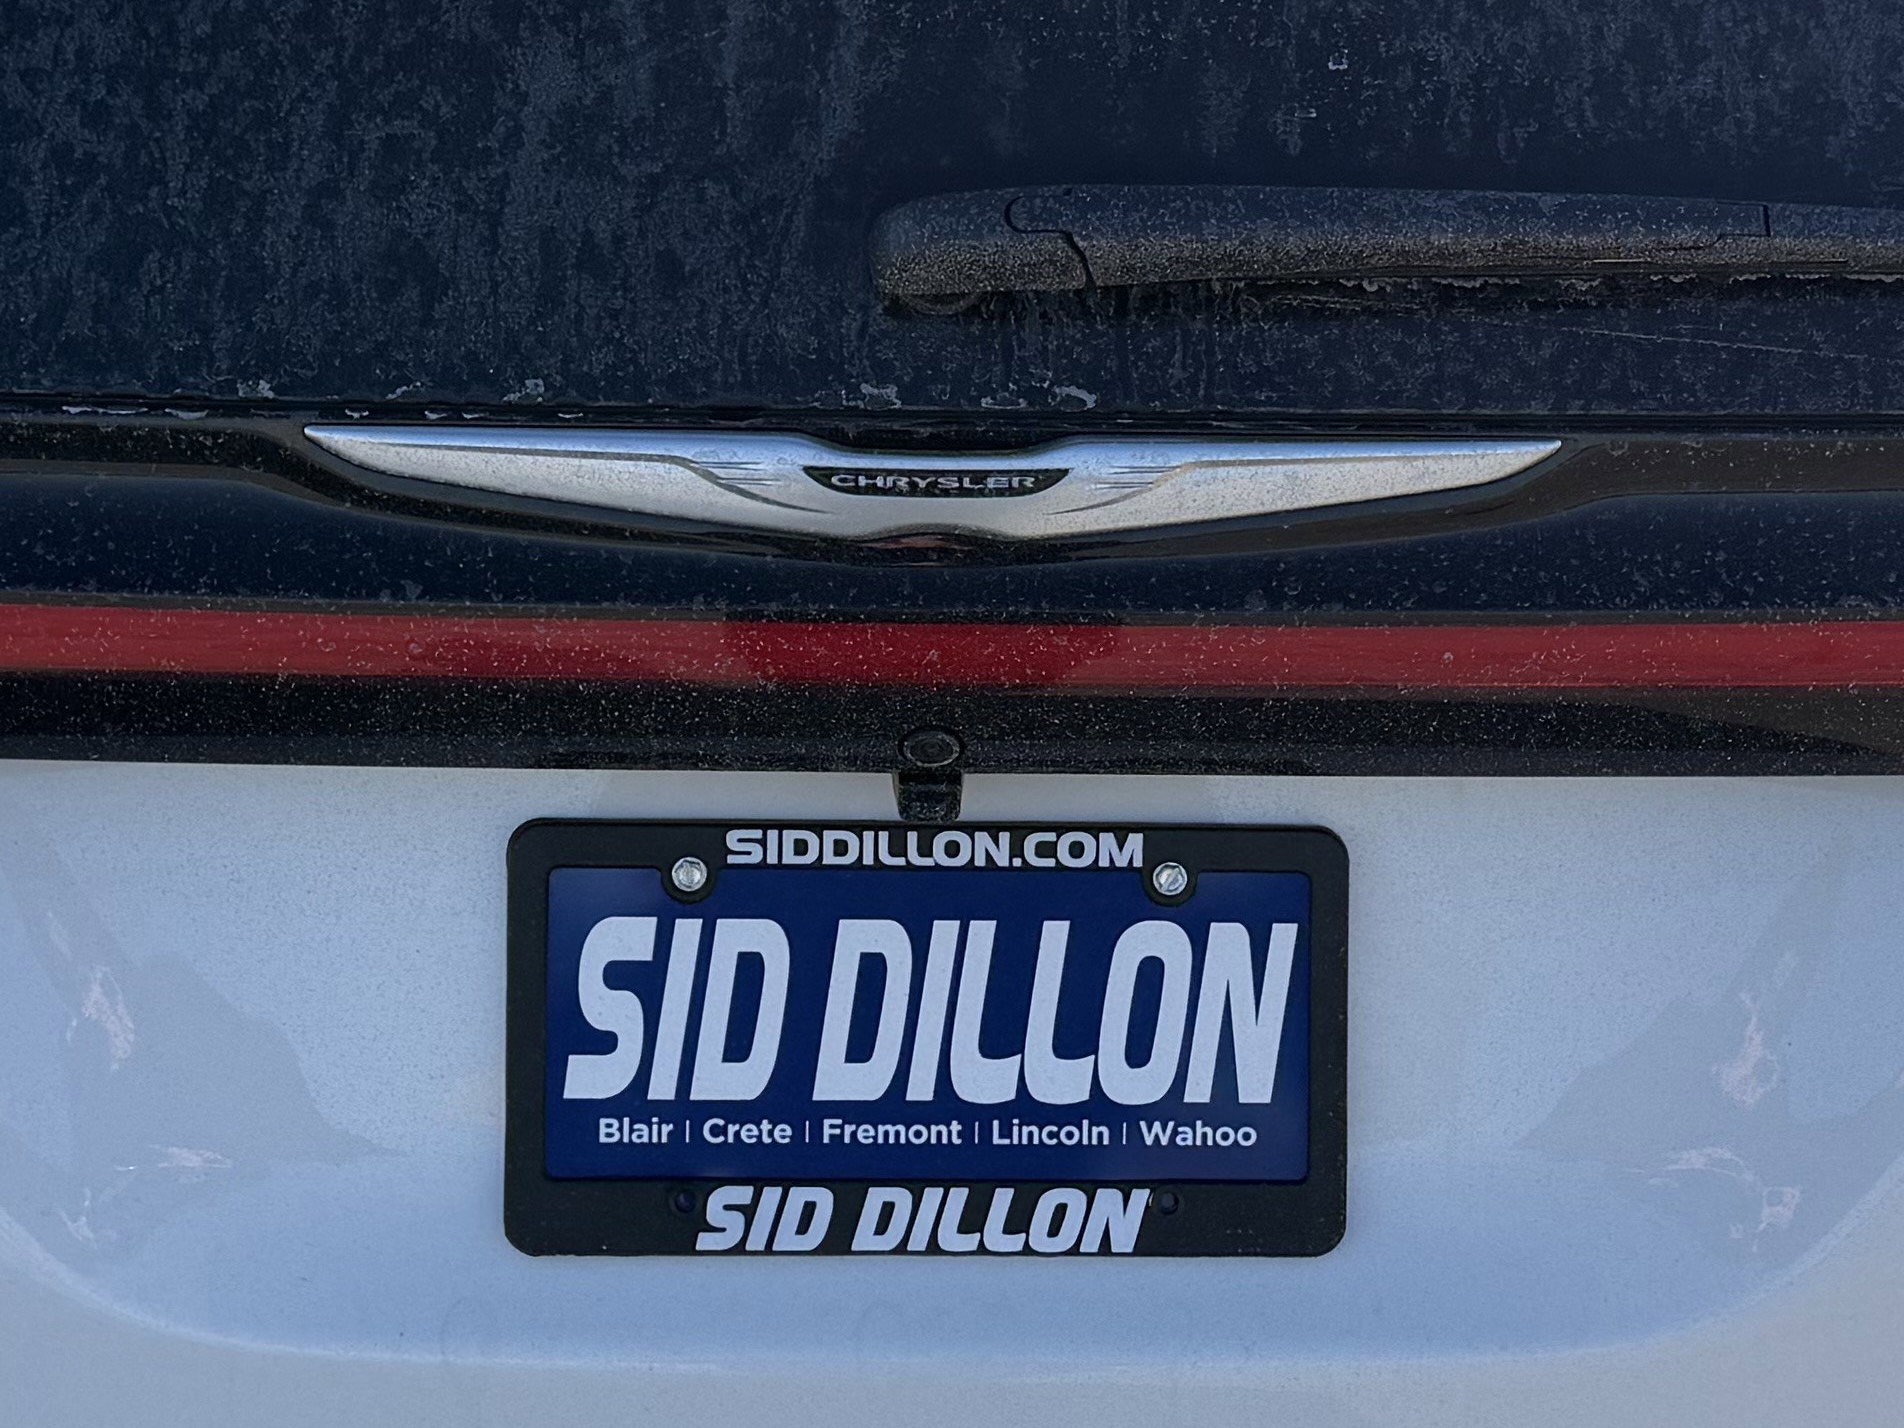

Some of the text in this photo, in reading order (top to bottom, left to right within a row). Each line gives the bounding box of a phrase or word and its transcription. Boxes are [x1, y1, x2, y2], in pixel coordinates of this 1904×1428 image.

[830, 473, 1034, 490] CHRYSLER
[725, 829, 1144, 868] SIDDILLON.COM
[563, 916, 1299, 1105] SID DILLON
[599, 1118, 1258, 1147] Blair Crete Fremont Lincoln Wahoo
[696, 1185, 1151, 1254] SID DILLON
